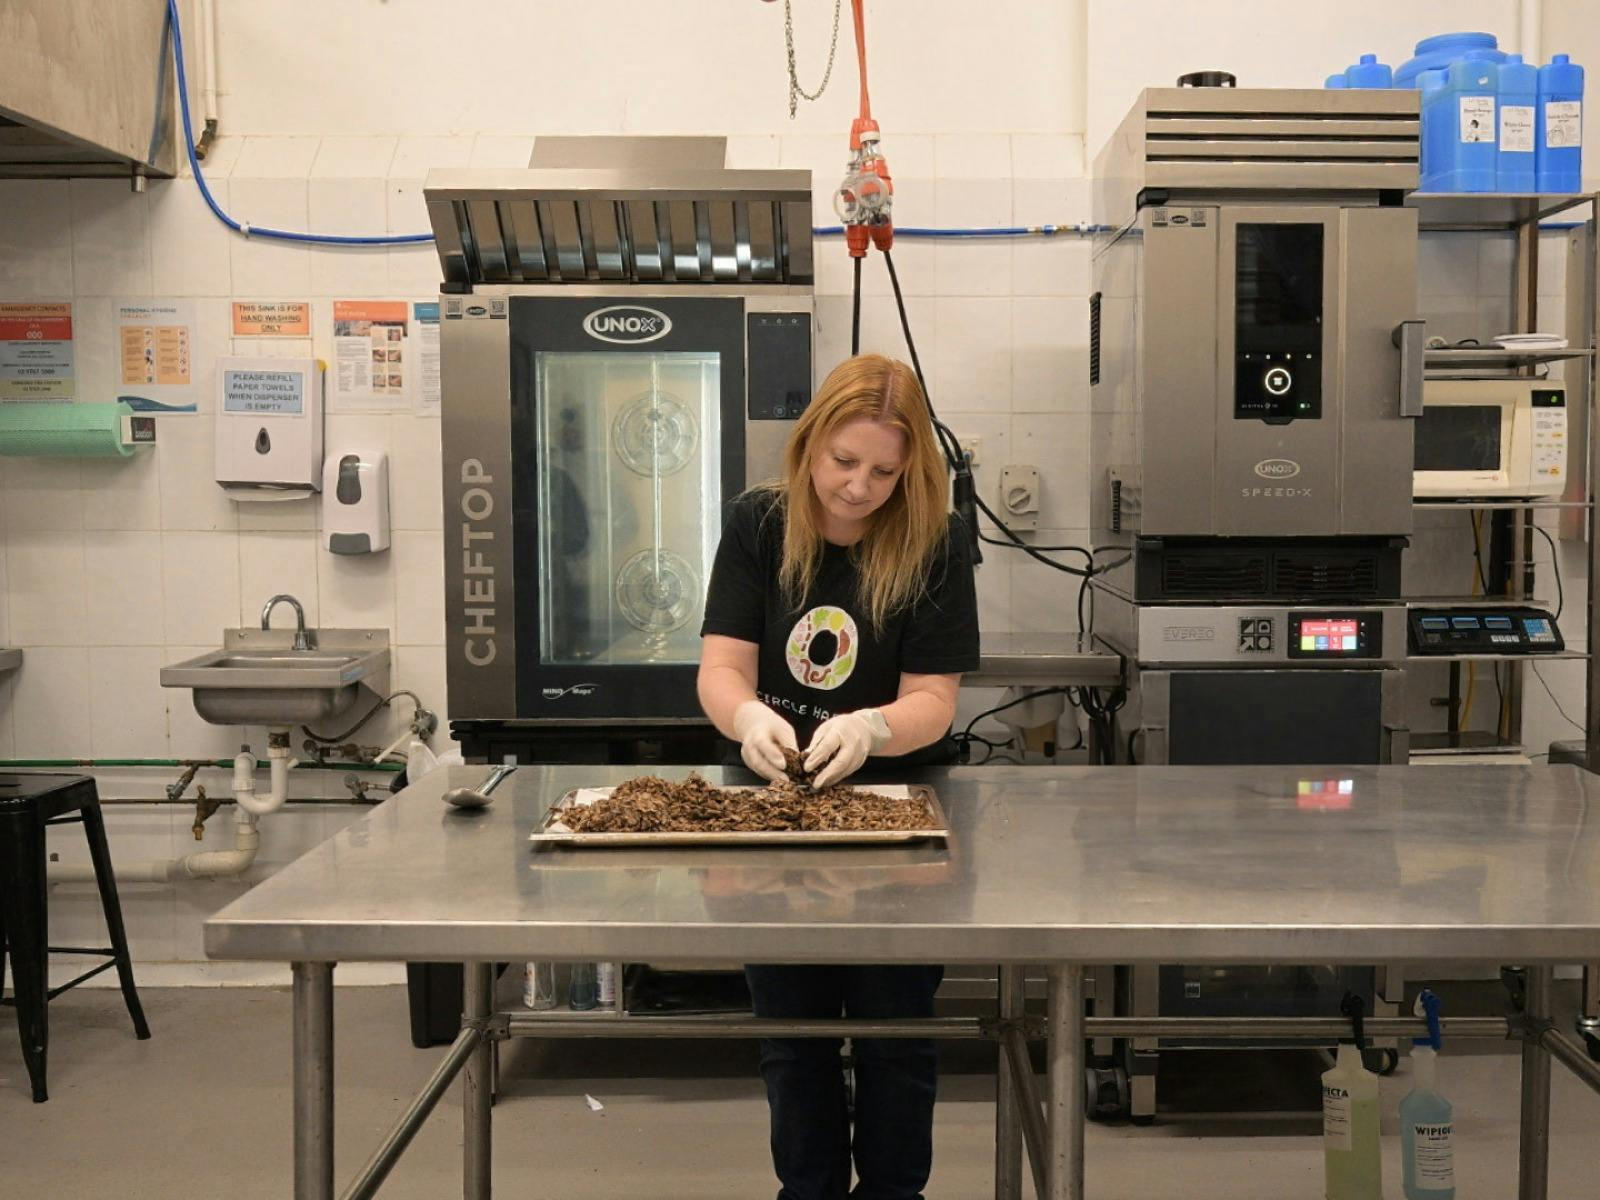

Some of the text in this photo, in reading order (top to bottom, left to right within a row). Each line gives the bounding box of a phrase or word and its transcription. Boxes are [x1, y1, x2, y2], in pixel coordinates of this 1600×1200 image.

[593, 317, 657, 333] UNOX
[254, 393, 299, 401] DISPENSER
[1260, 464, 1294, 474] UNOX
[461, 458, 497, 666] CHEFTOP
